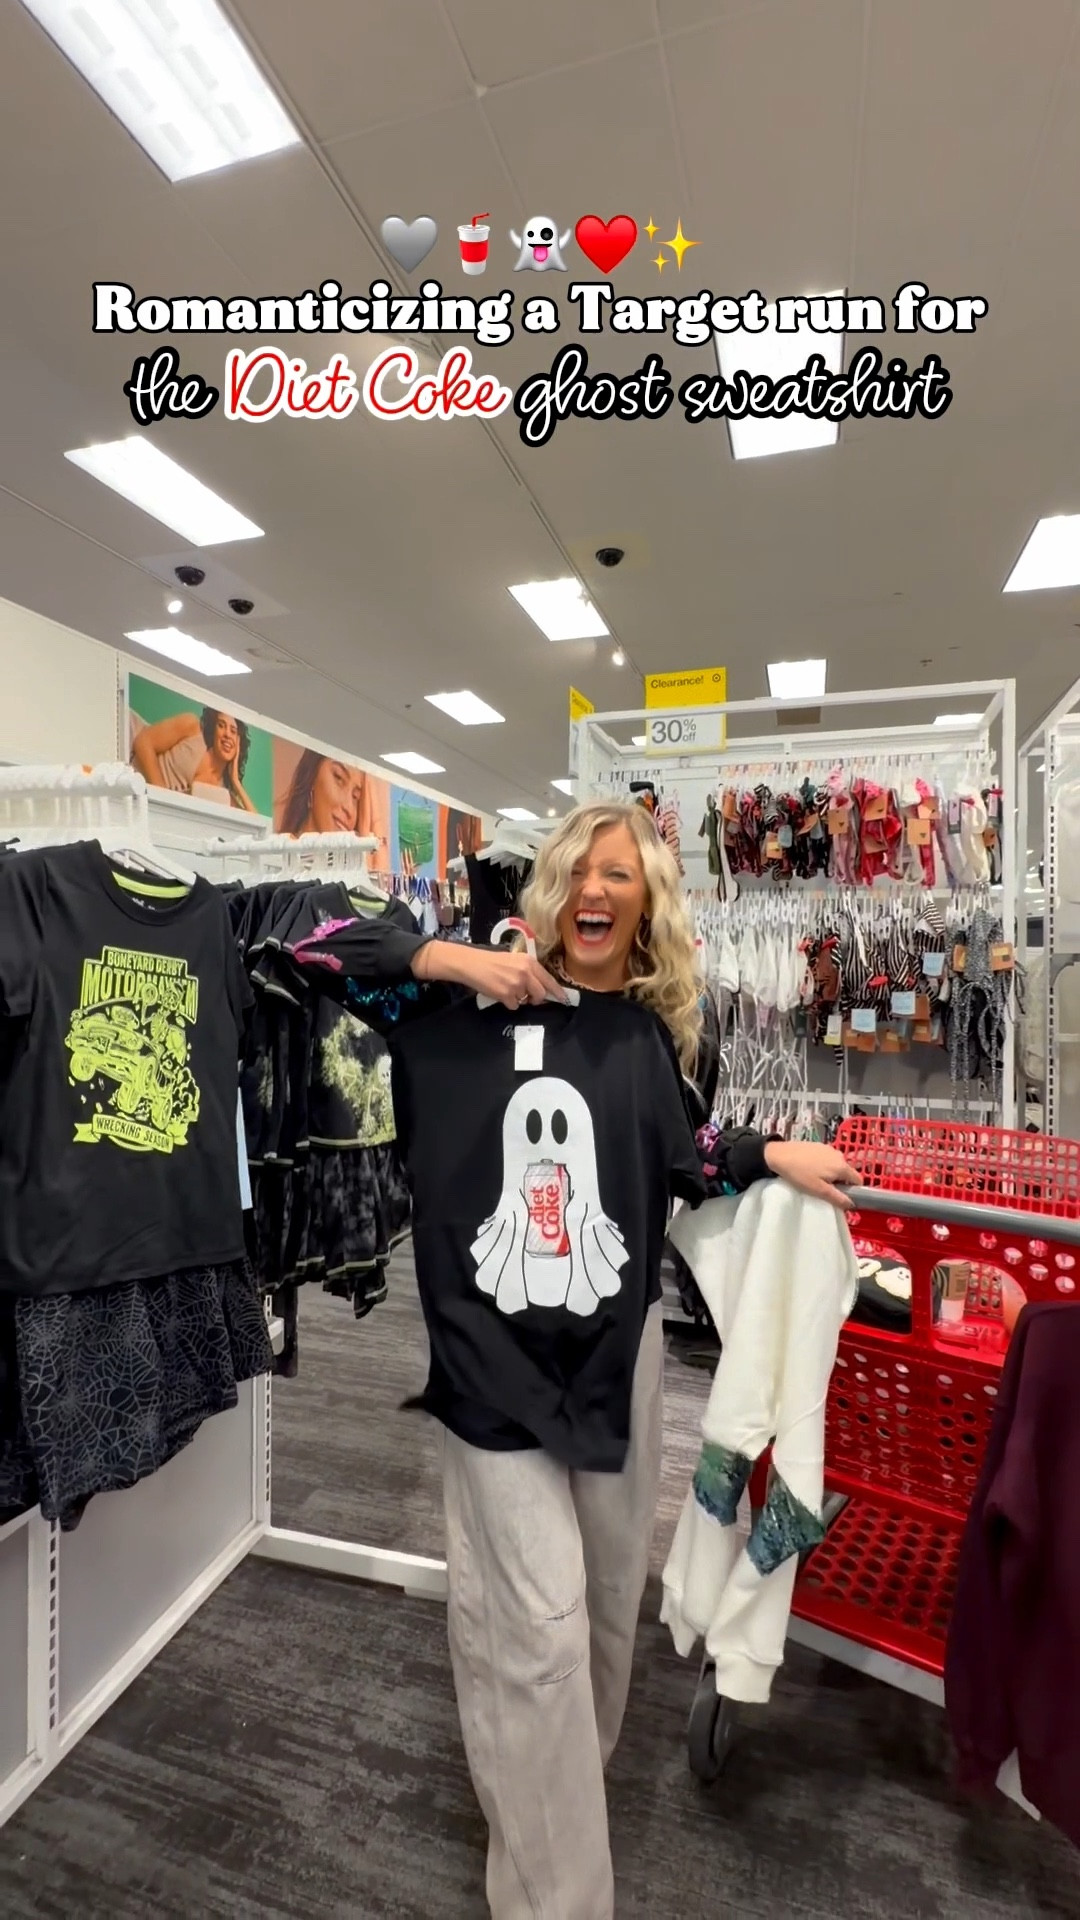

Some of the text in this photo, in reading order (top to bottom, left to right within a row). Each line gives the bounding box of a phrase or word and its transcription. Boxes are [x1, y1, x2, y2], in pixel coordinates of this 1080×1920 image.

[650, 675, 704, 689] Clearance!
[682, 732, 697, 742] off
[106, 951, 155, 973] BONEYARD
[95, 1117, 171, 1149] WRECKING SEASON
[530, 1186, 545, 1225] diet
[541, 1184, 561, 1240] Coke
